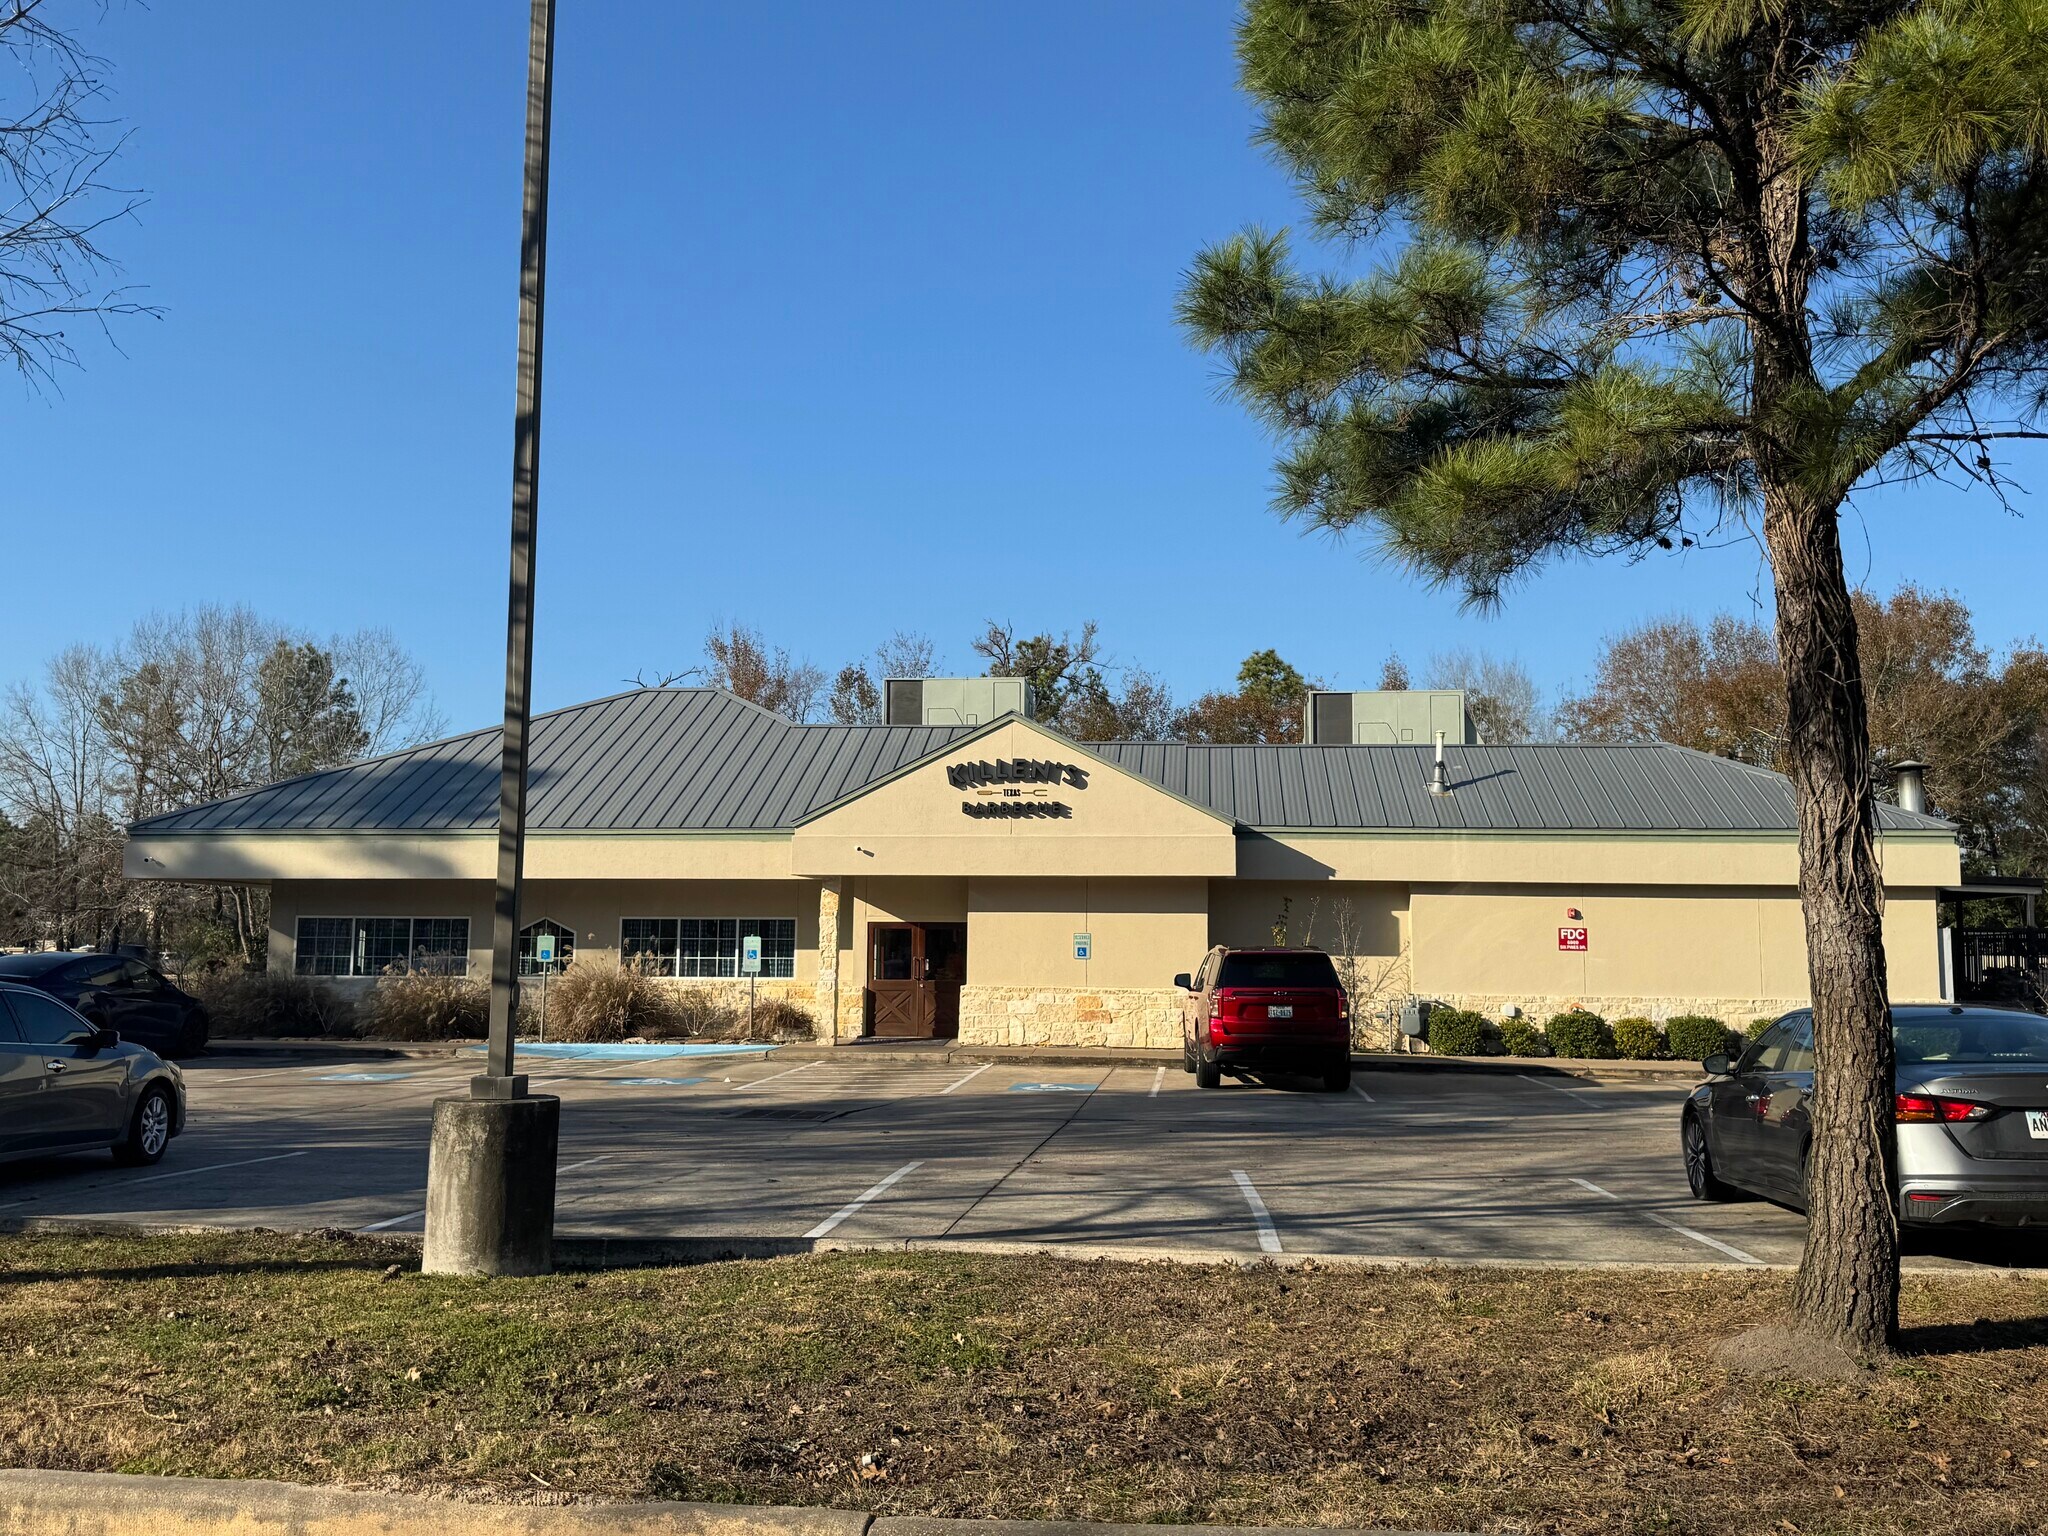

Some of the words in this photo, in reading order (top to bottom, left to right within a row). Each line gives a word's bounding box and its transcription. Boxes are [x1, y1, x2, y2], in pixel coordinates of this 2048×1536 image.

[946, 758, 1086, 787] KILLEN'S
[1003, 789, 1021, 797] TEXAS
[962, 802, 1064, 816] BARBECUE
[1560, 929, 1585, 940] FDC
[2033, 1118, 2048, 1131] AN
